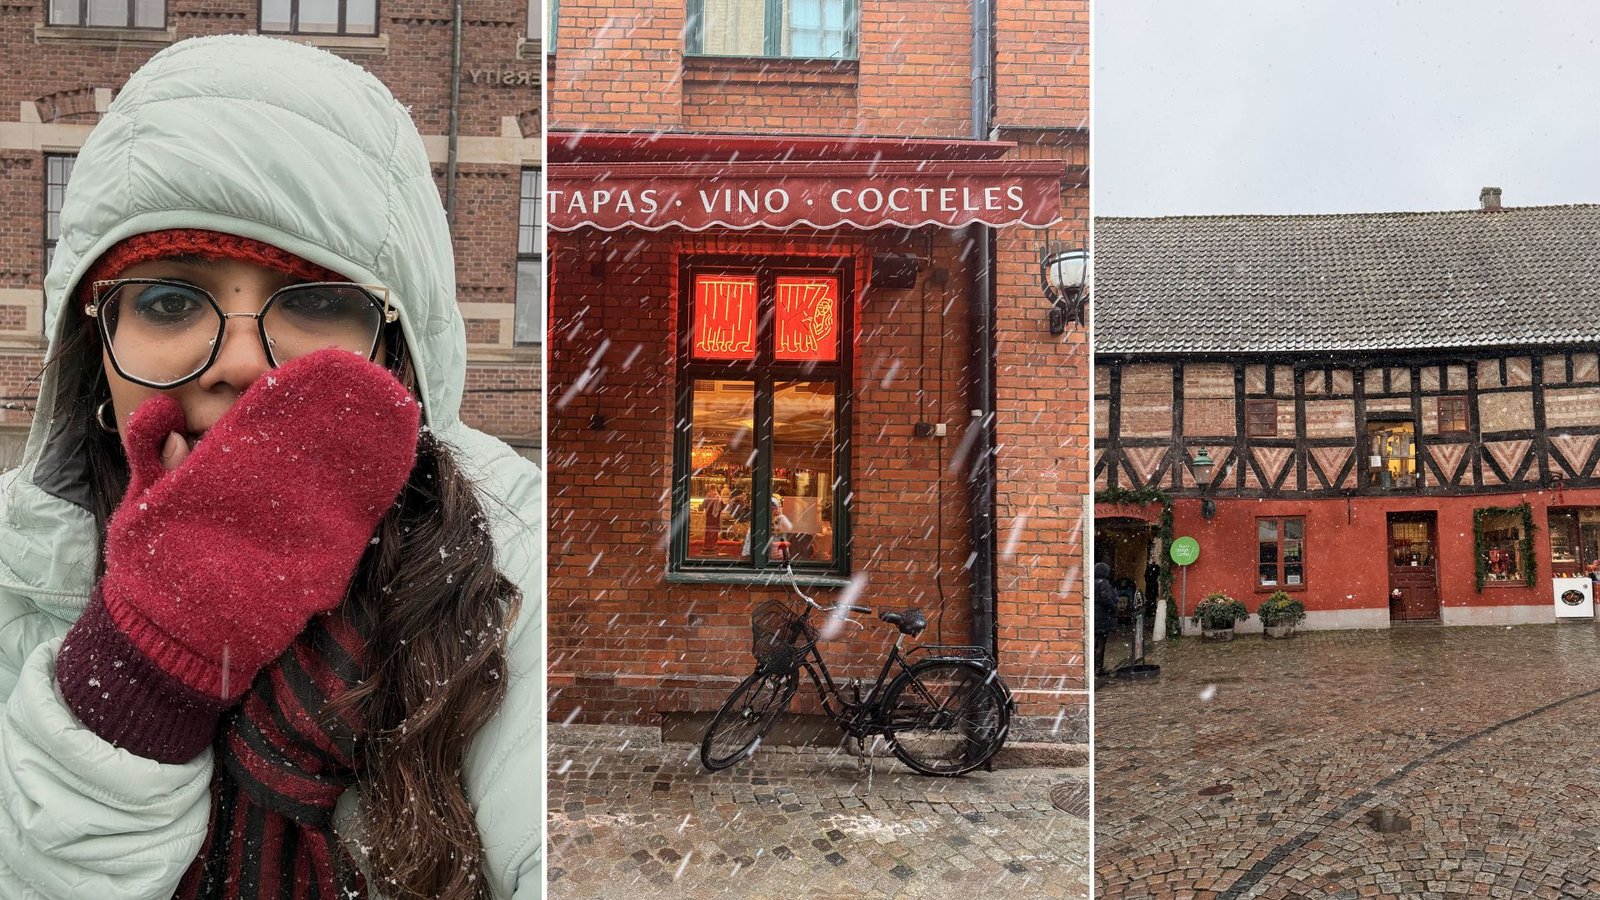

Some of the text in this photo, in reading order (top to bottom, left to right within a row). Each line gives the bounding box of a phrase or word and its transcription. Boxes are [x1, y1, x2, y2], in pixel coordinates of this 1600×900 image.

[547, 186, 1024, 214] TAPAS VINO COCTELES
